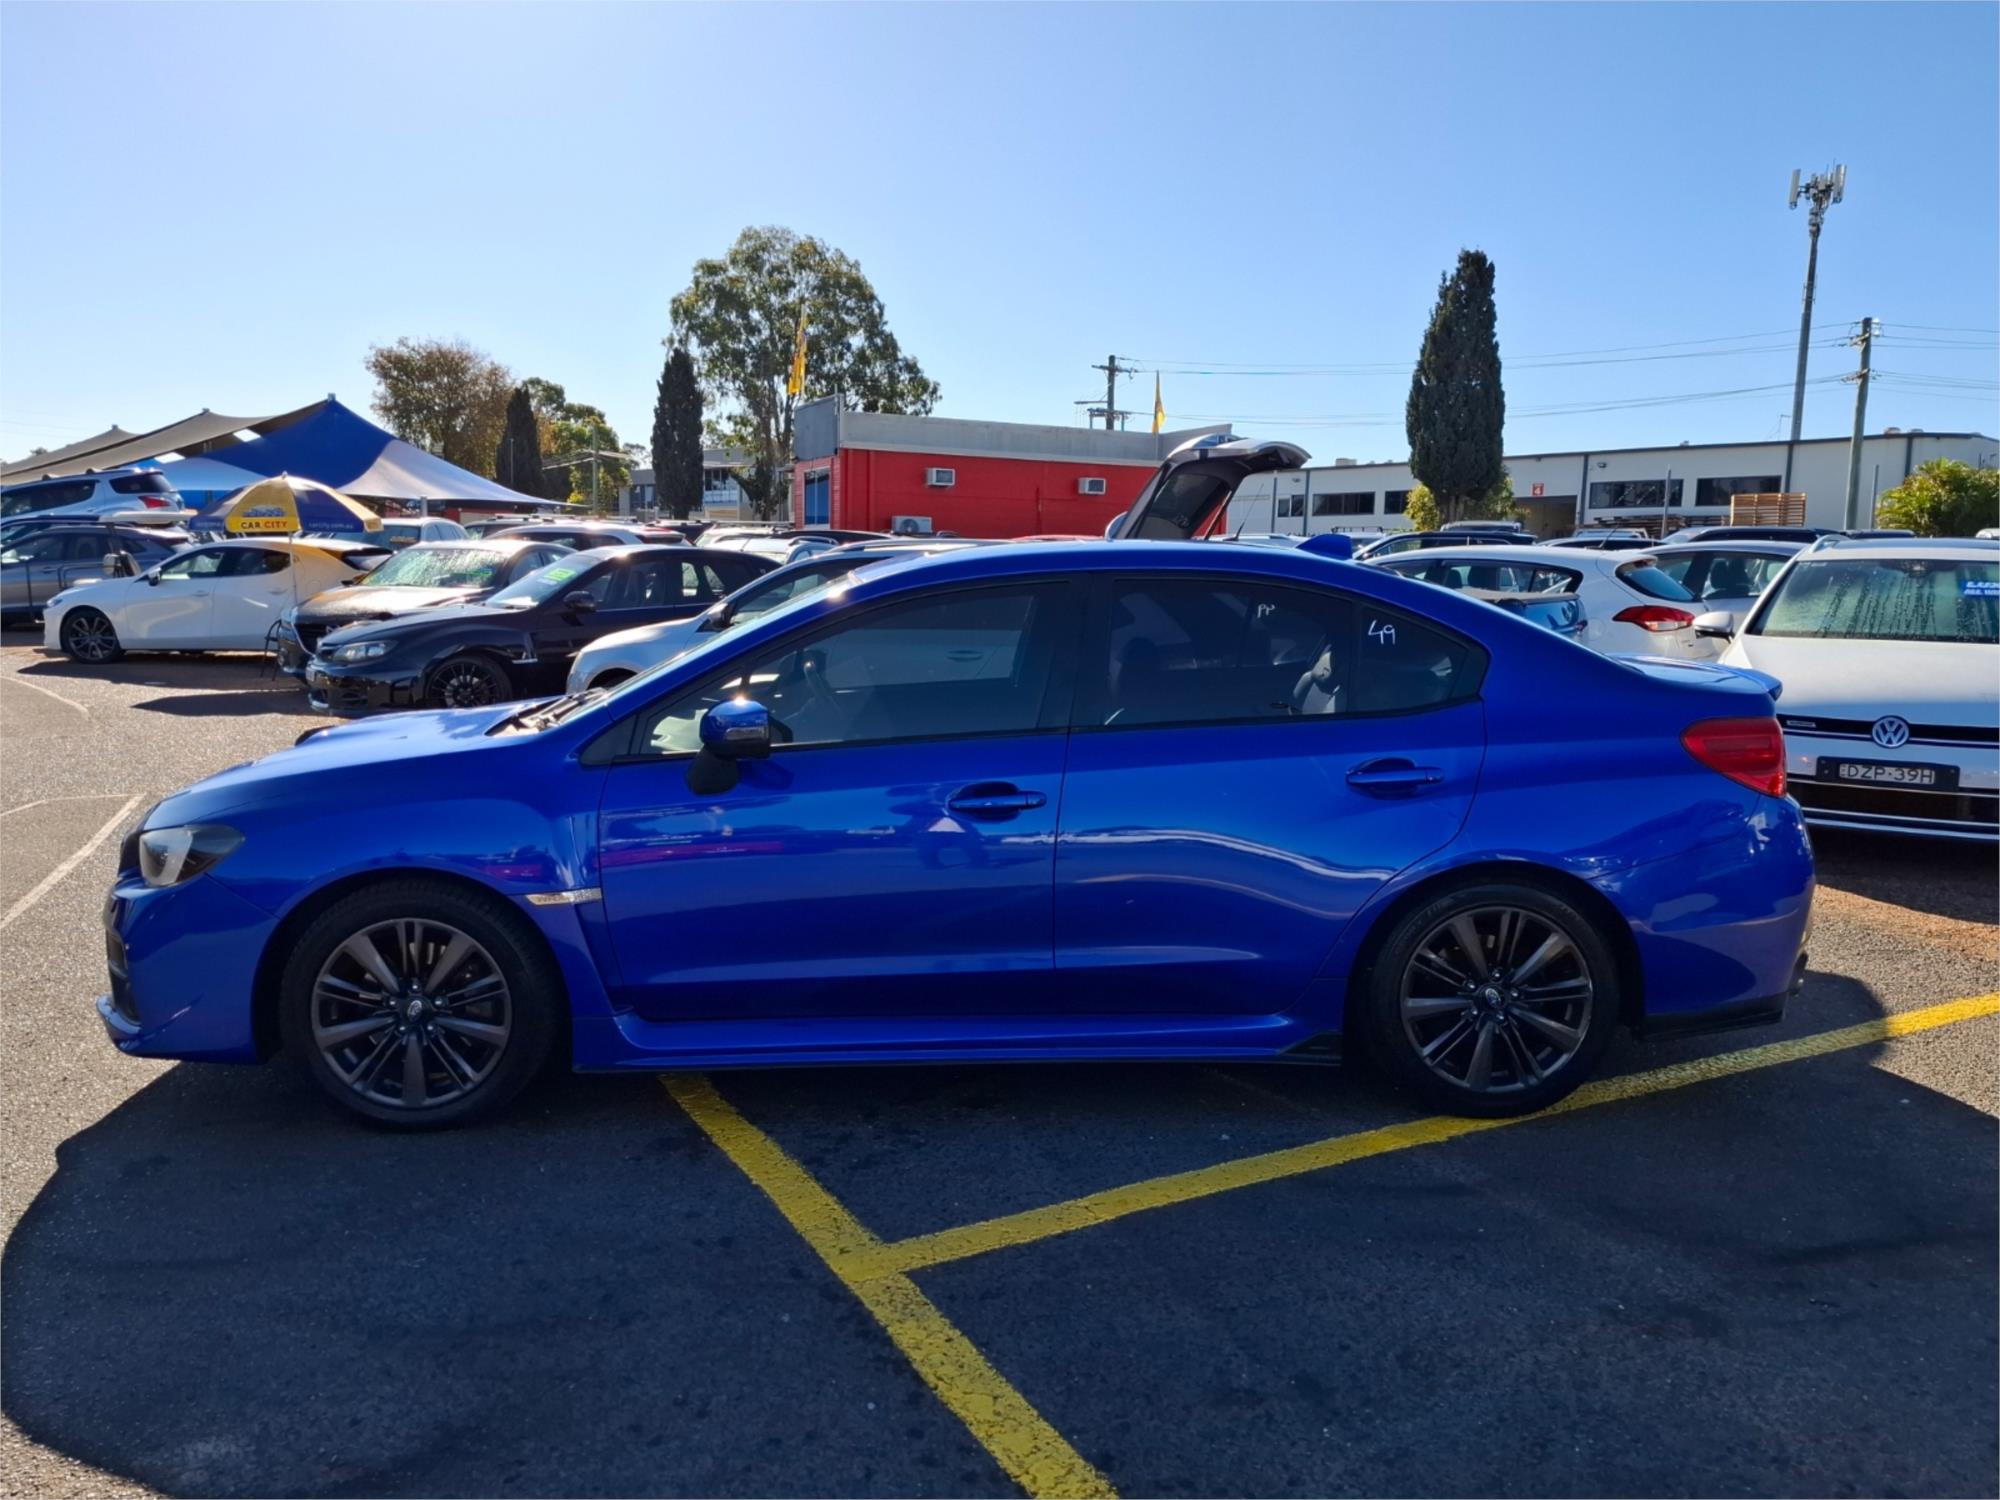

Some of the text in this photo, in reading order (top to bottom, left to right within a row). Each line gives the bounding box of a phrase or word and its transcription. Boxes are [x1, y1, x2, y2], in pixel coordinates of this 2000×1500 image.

[240, 520, 288, 530] CAR CITY
[1368, 619, 1396, 645] 49
